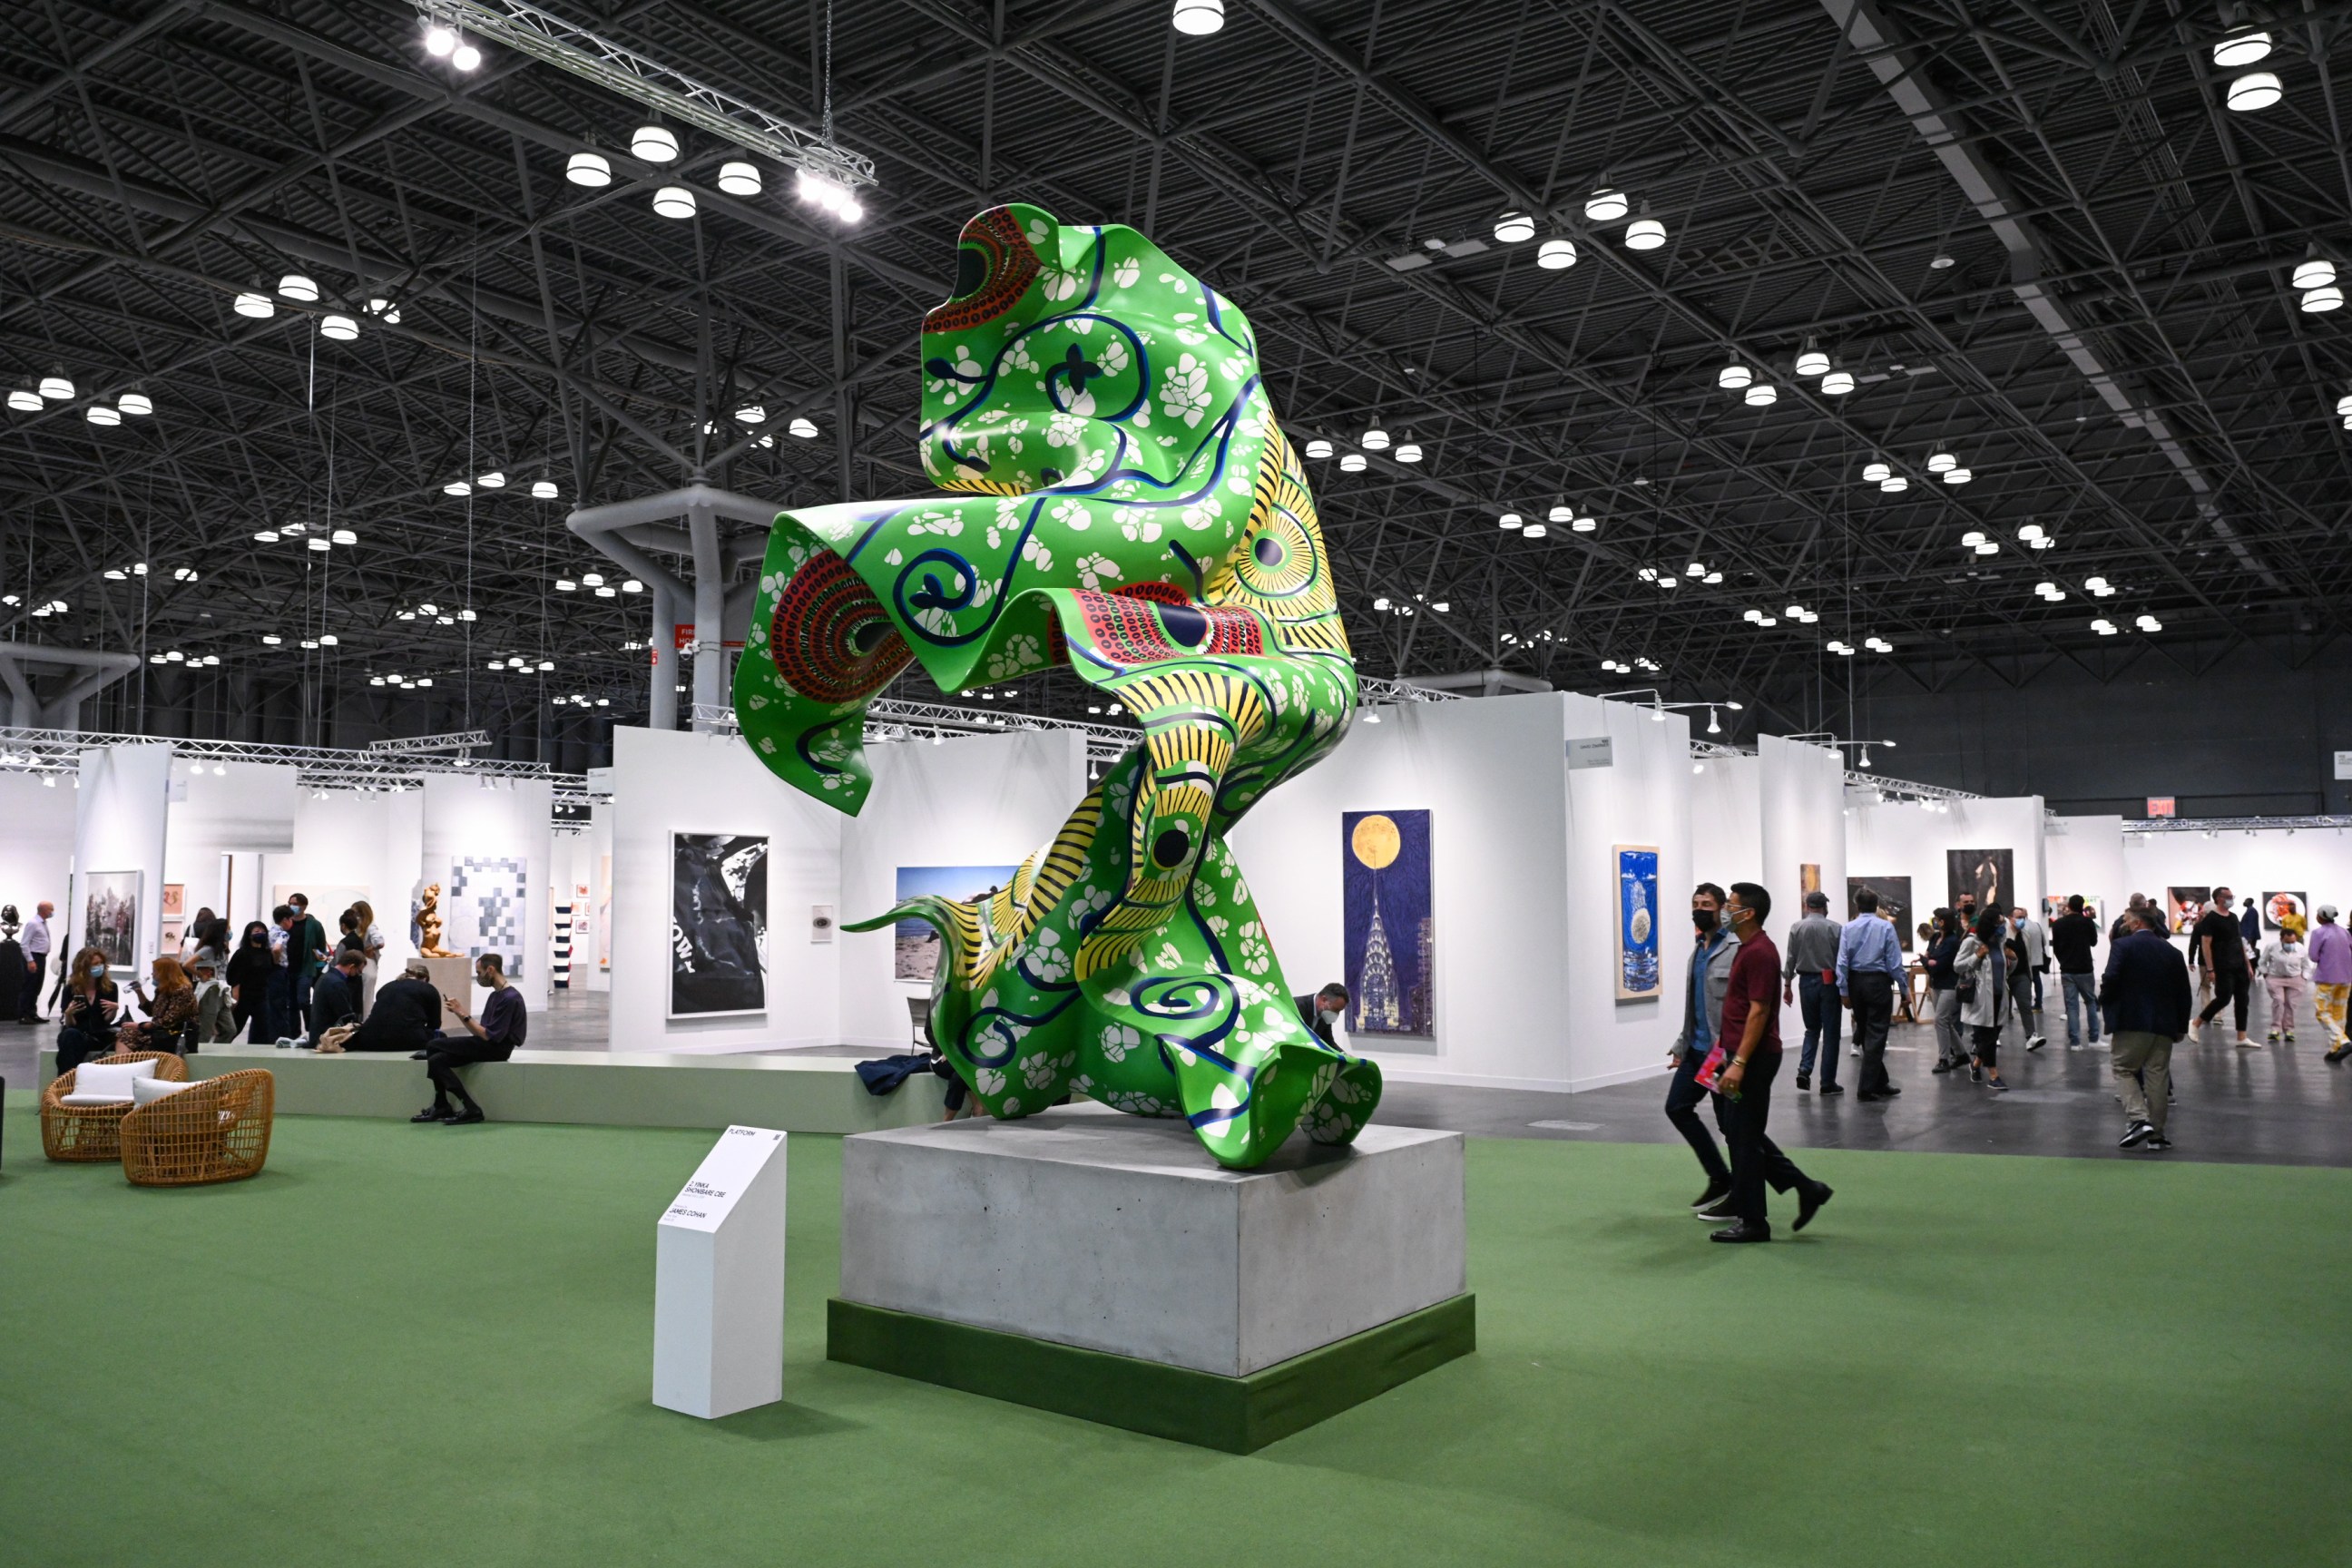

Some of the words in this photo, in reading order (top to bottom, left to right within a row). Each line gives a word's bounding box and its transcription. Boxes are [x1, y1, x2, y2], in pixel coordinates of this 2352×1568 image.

[2149, 799, 2174, 814] EXIT
[684, 1187, 714, 1196] SHONIBARE
[687, 1210, 707, 1219] COHAN
